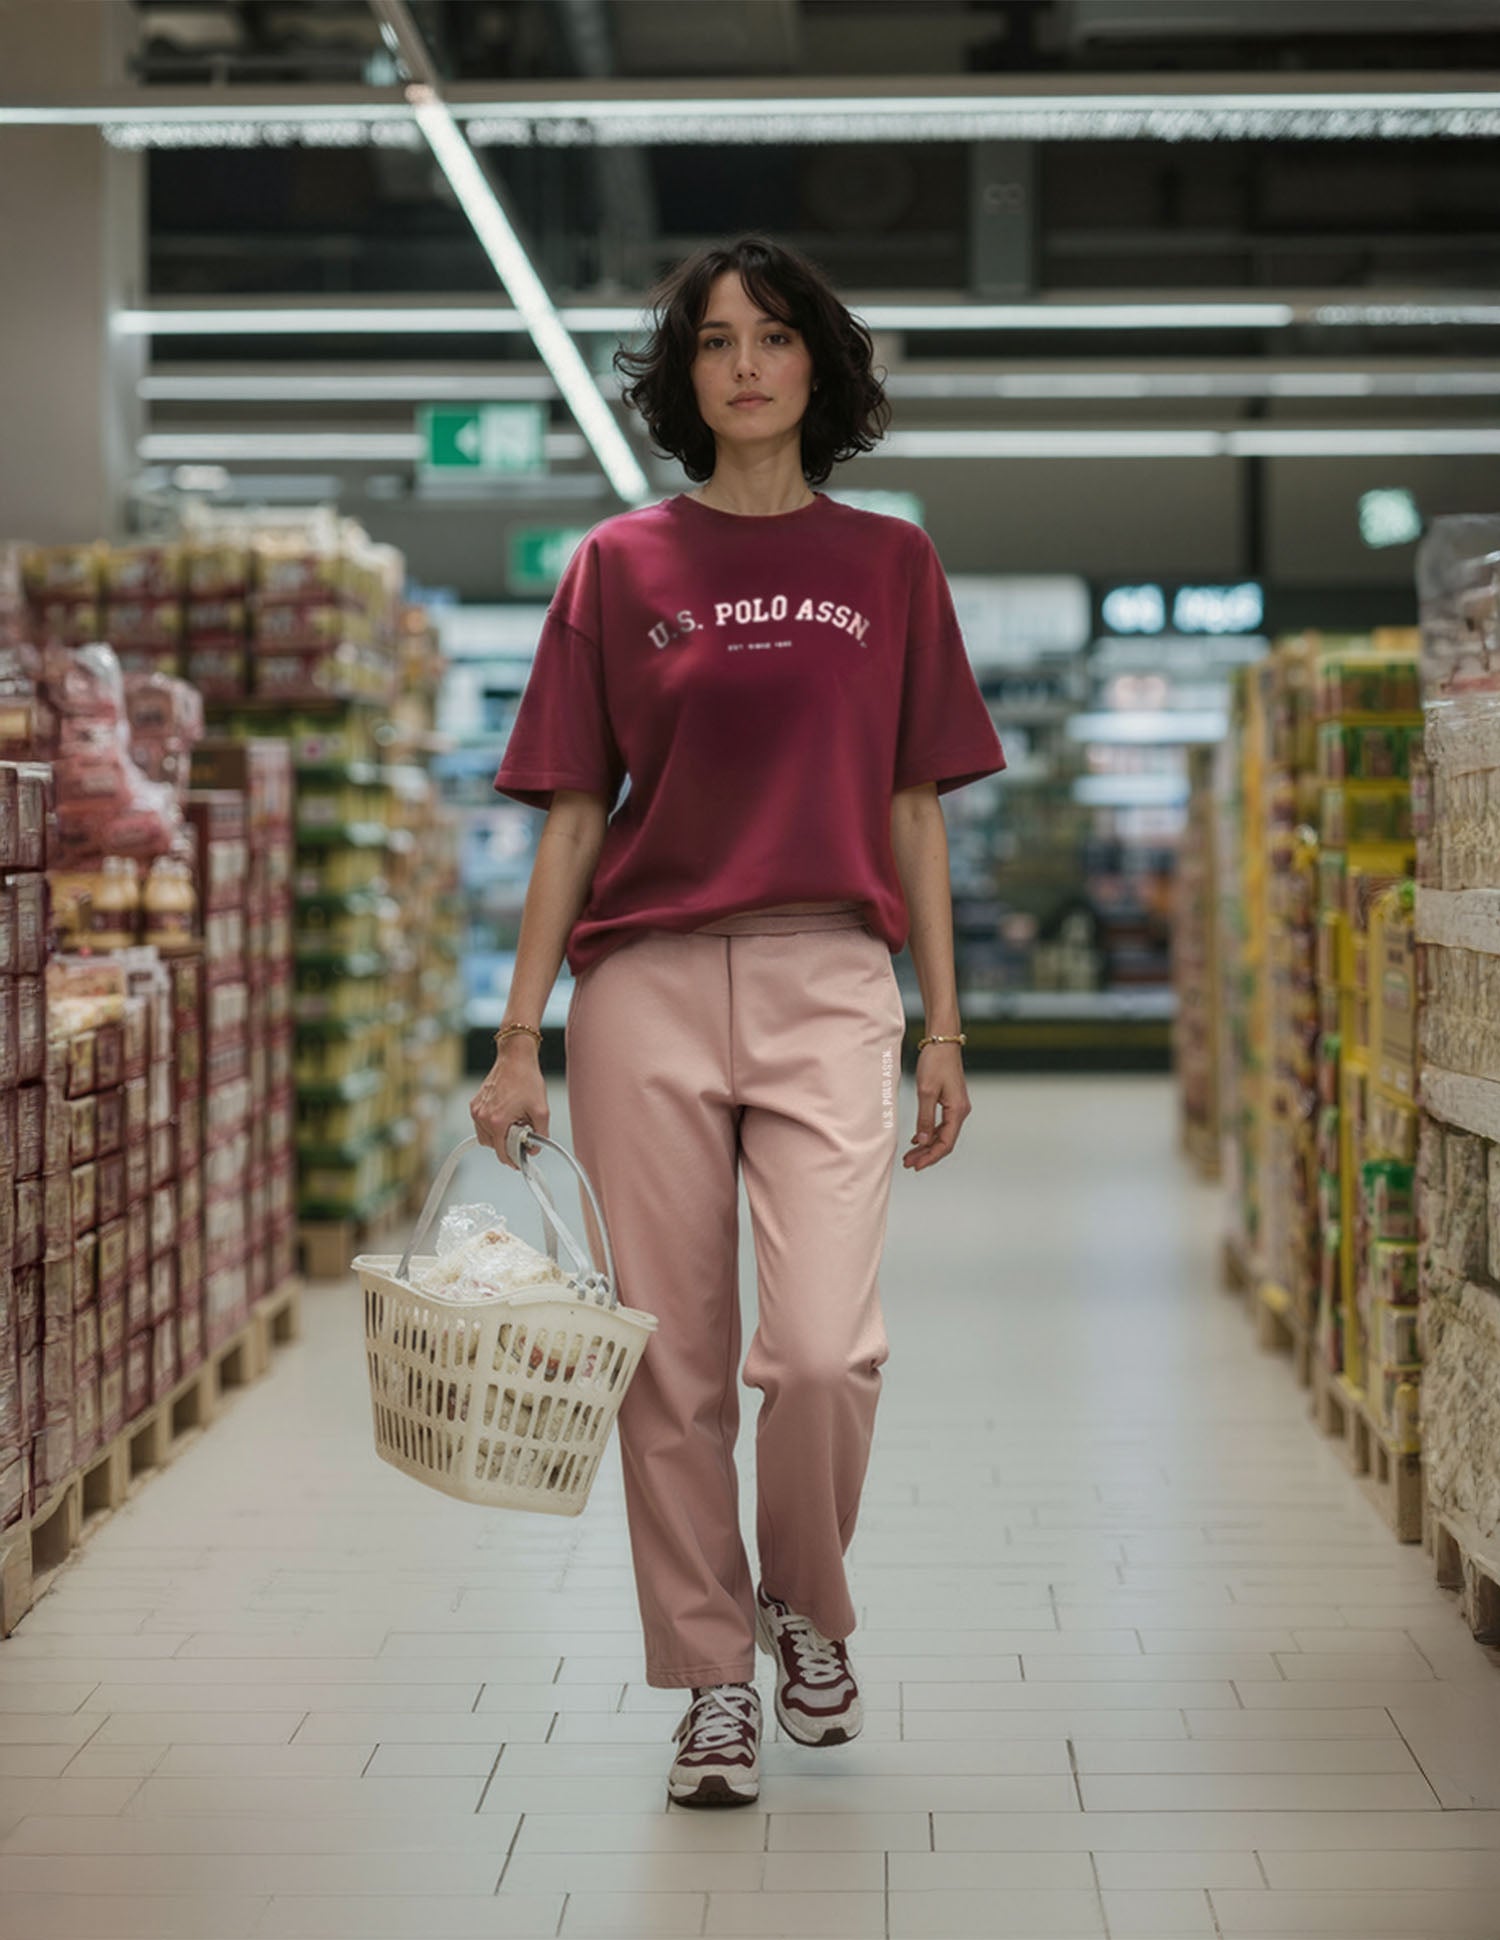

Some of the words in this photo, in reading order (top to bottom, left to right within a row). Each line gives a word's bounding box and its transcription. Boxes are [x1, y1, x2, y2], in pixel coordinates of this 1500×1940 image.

[648, 610, 704, 649] U.S.
[714, 595, 788, 626] POLO
[795, 598, 870, 649] ASSN.
[882, 1079, 893, 1106] POLO
